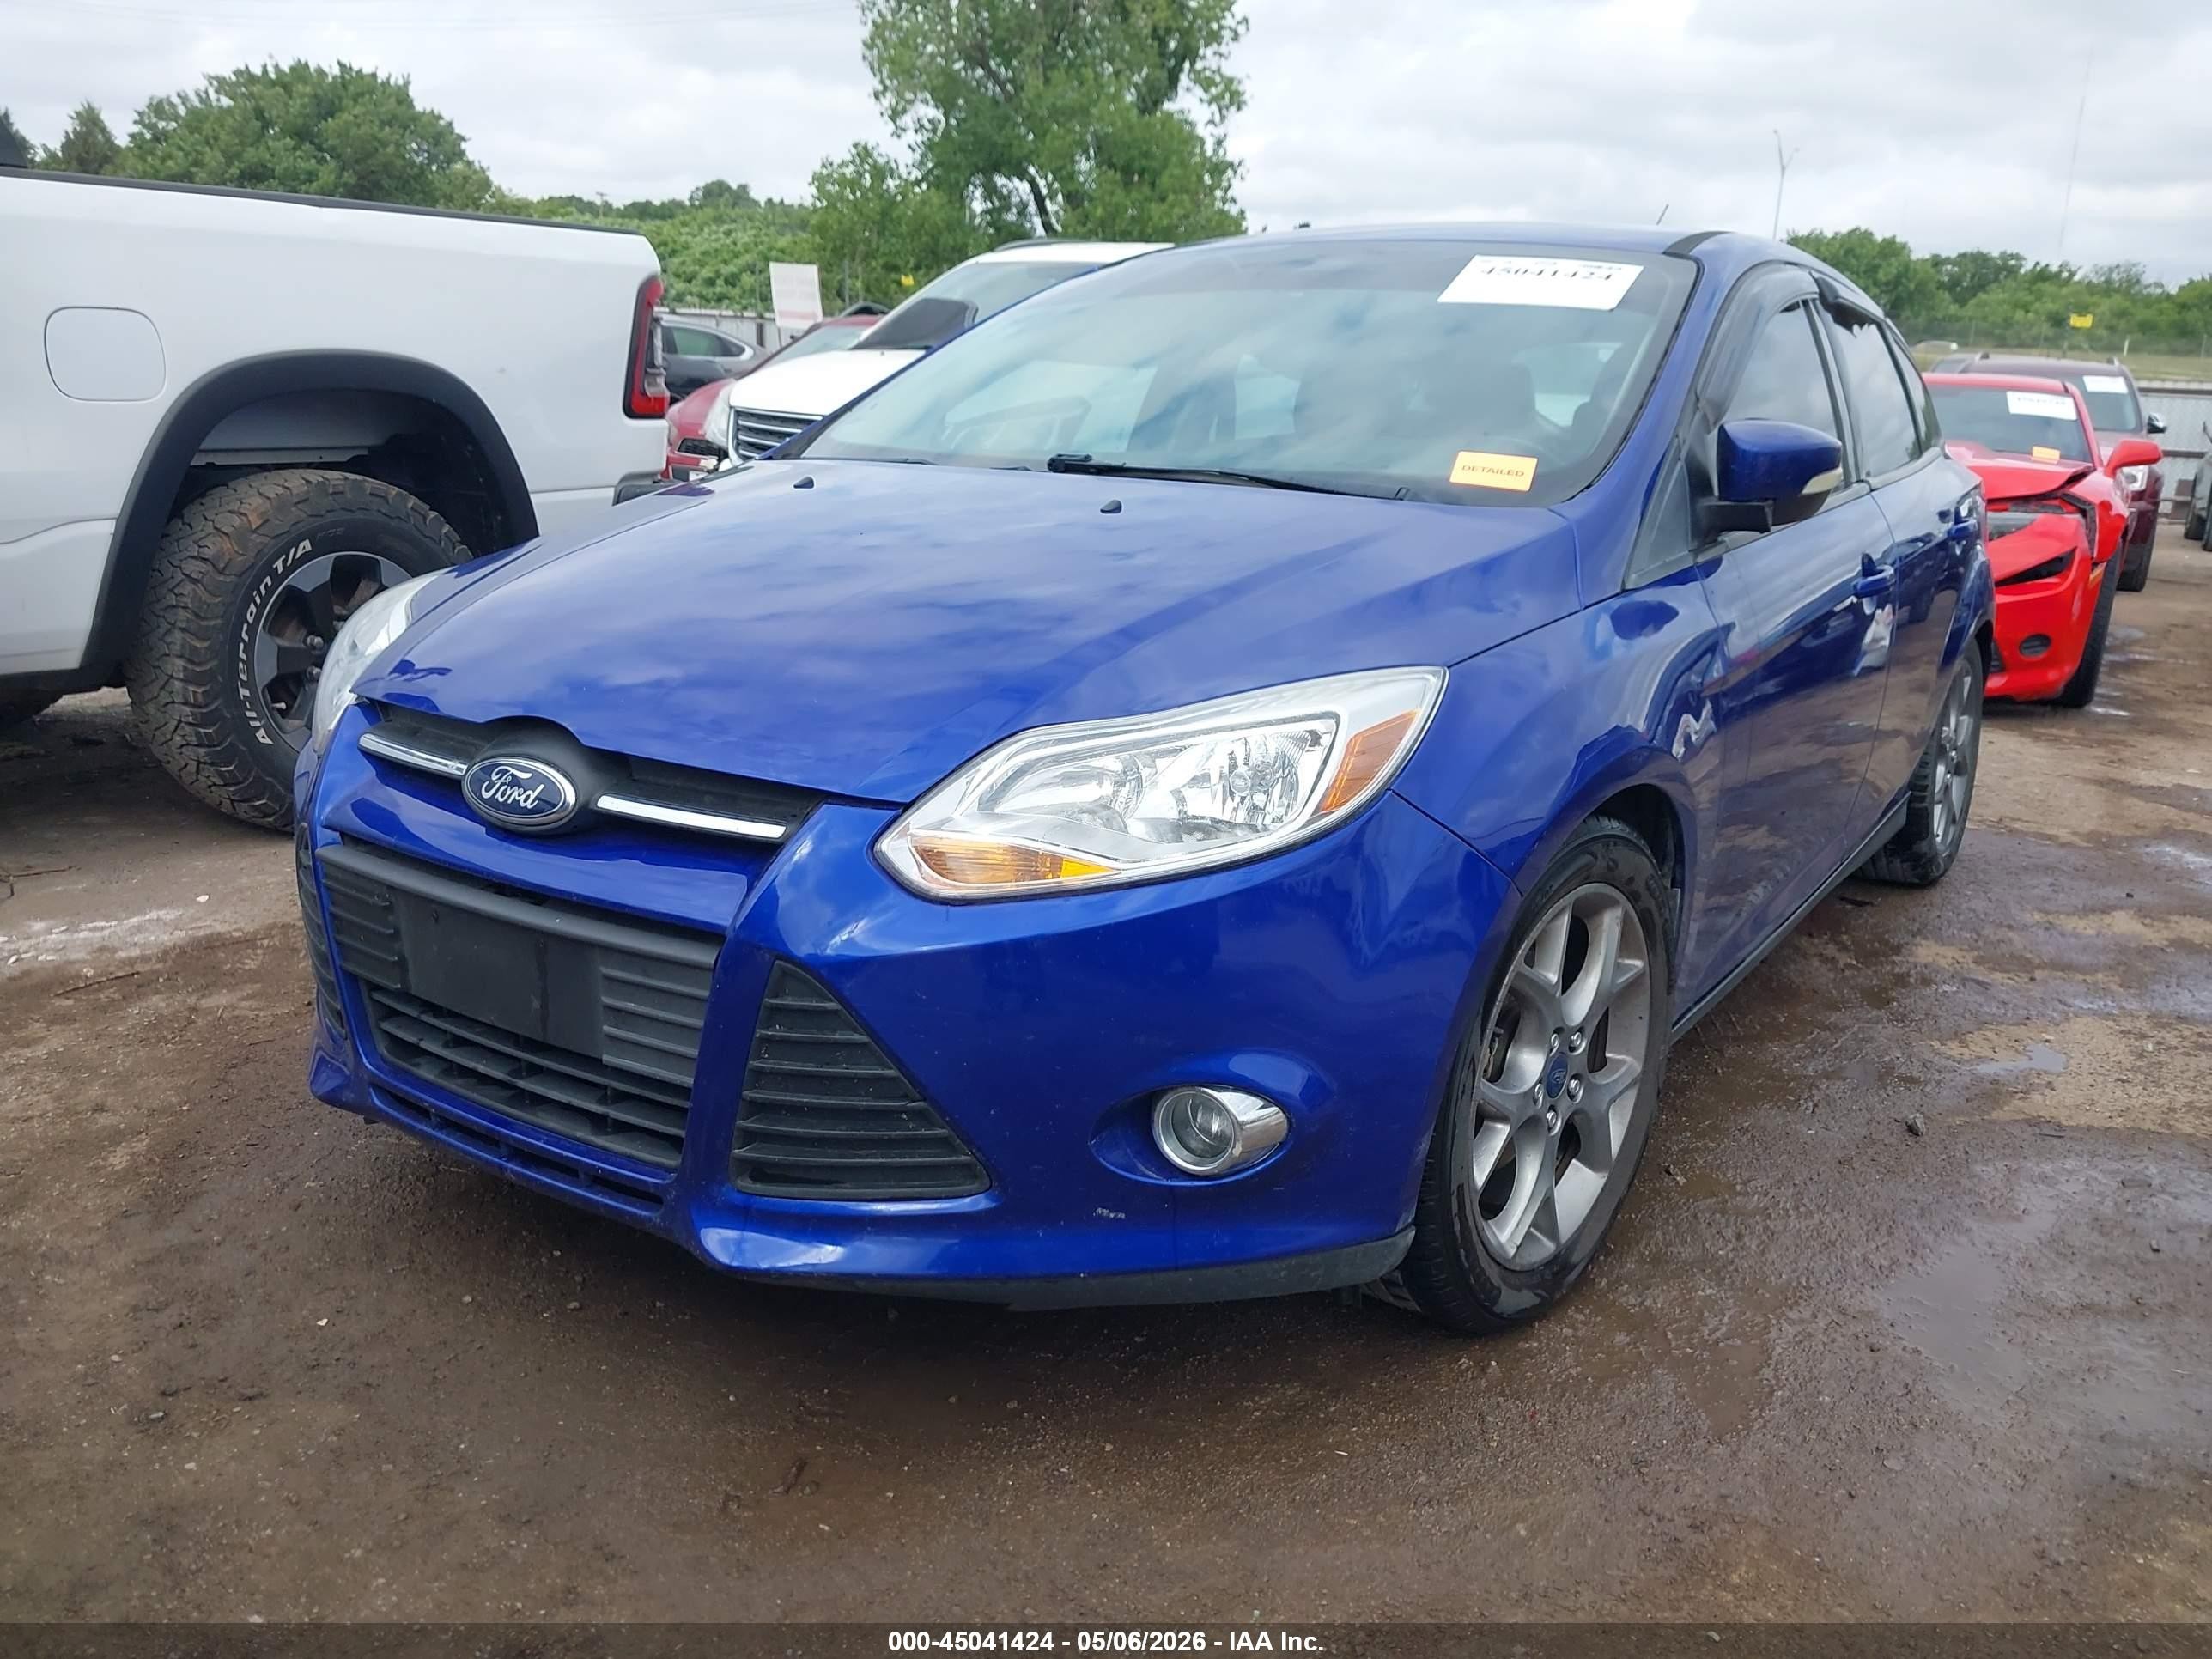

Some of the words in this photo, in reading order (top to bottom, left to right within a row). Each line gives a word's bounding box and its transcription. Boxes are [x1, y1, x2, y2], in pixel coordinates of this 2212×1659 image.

[1462, 464, 1525, 477] DETAILED
[237, 574, 274, 745] All-Terrain
[272, 538, 313, 575] T/A
[481, 765, 545, 810] Ford
